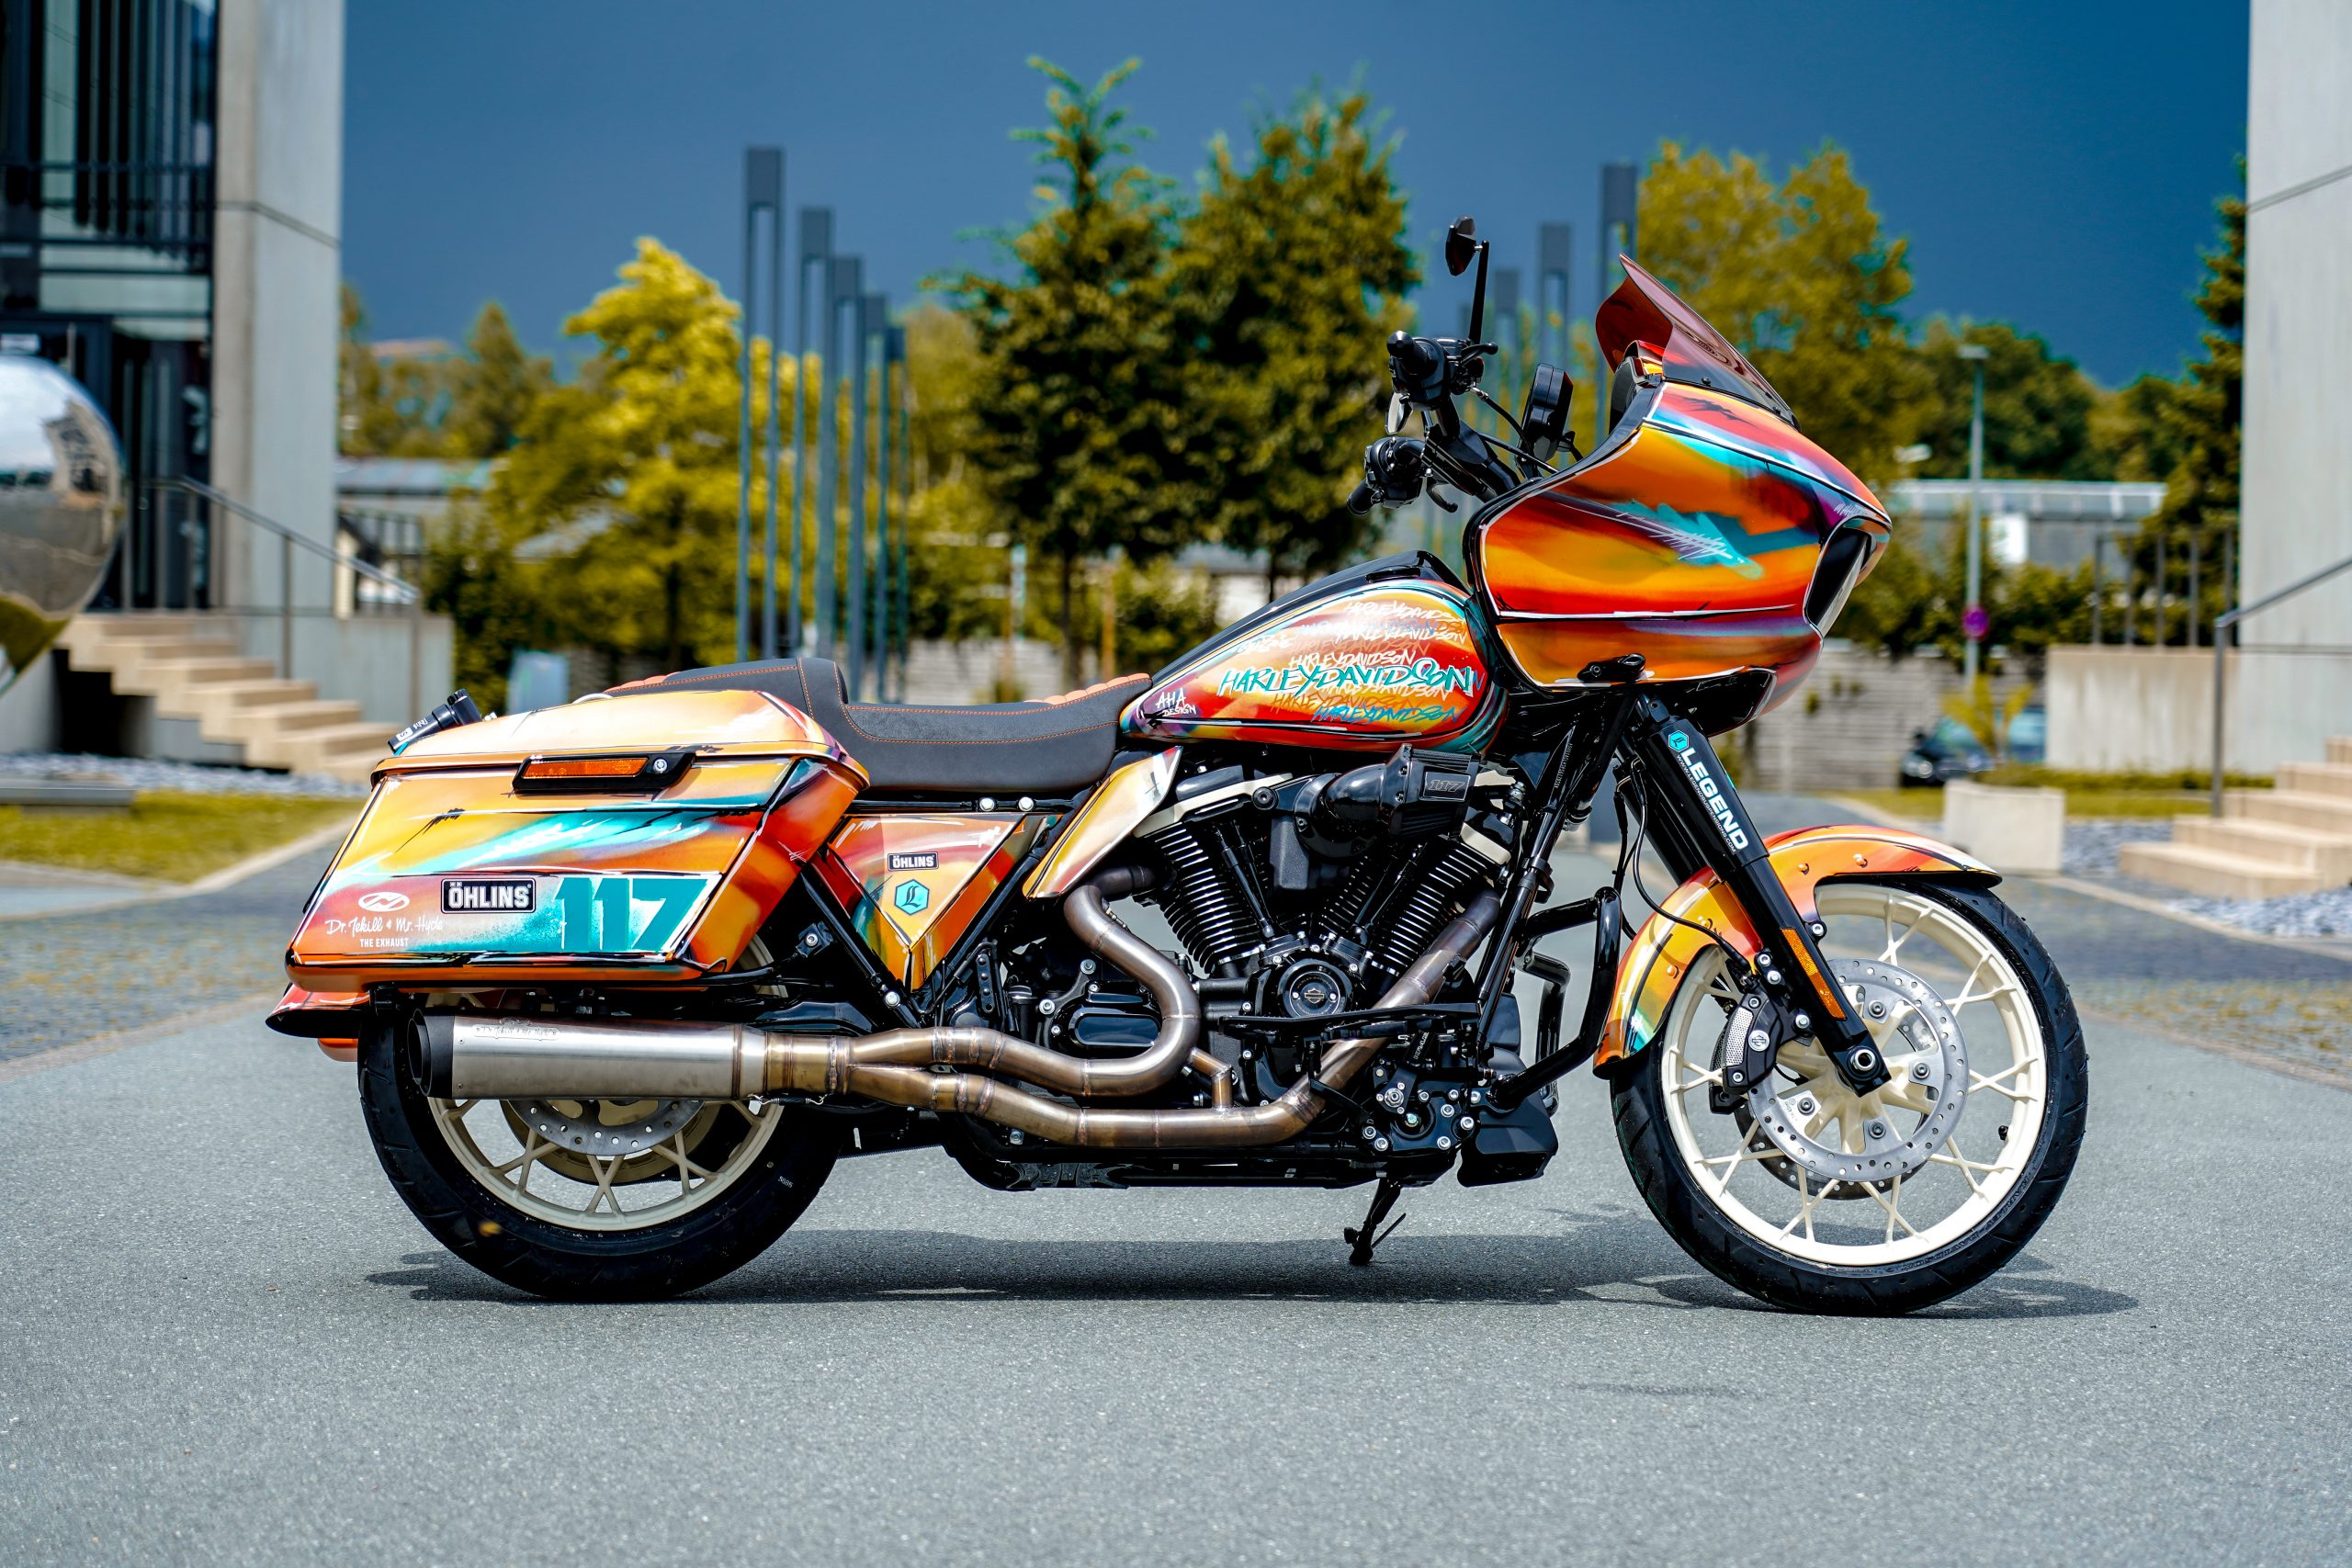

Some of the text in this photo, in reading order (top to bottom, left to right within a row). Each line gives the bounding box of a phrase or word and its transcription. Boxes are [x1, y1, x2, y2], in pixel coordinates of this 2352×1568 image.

[1155, 686, 1187, 709] AHA
[1162, 703, 1197, 717] DESIGN
[1428, 779, 1465, 793] 117
[1679, 747, 1749, 851] LEGEND
[892, 855, 935, 869] ÖHLINS
[447, 881, 532, 909] ÖHLINS
[551, 876, 708, 953] 117
[324, 919, 347, 935] Dr.
[348, 916, 383, 938] Jekill
[395, 917, 413, 932] Mr.
[414, 915, 443, 936] Hyde
[359, 937, 409, 948] THE EXHAUST
